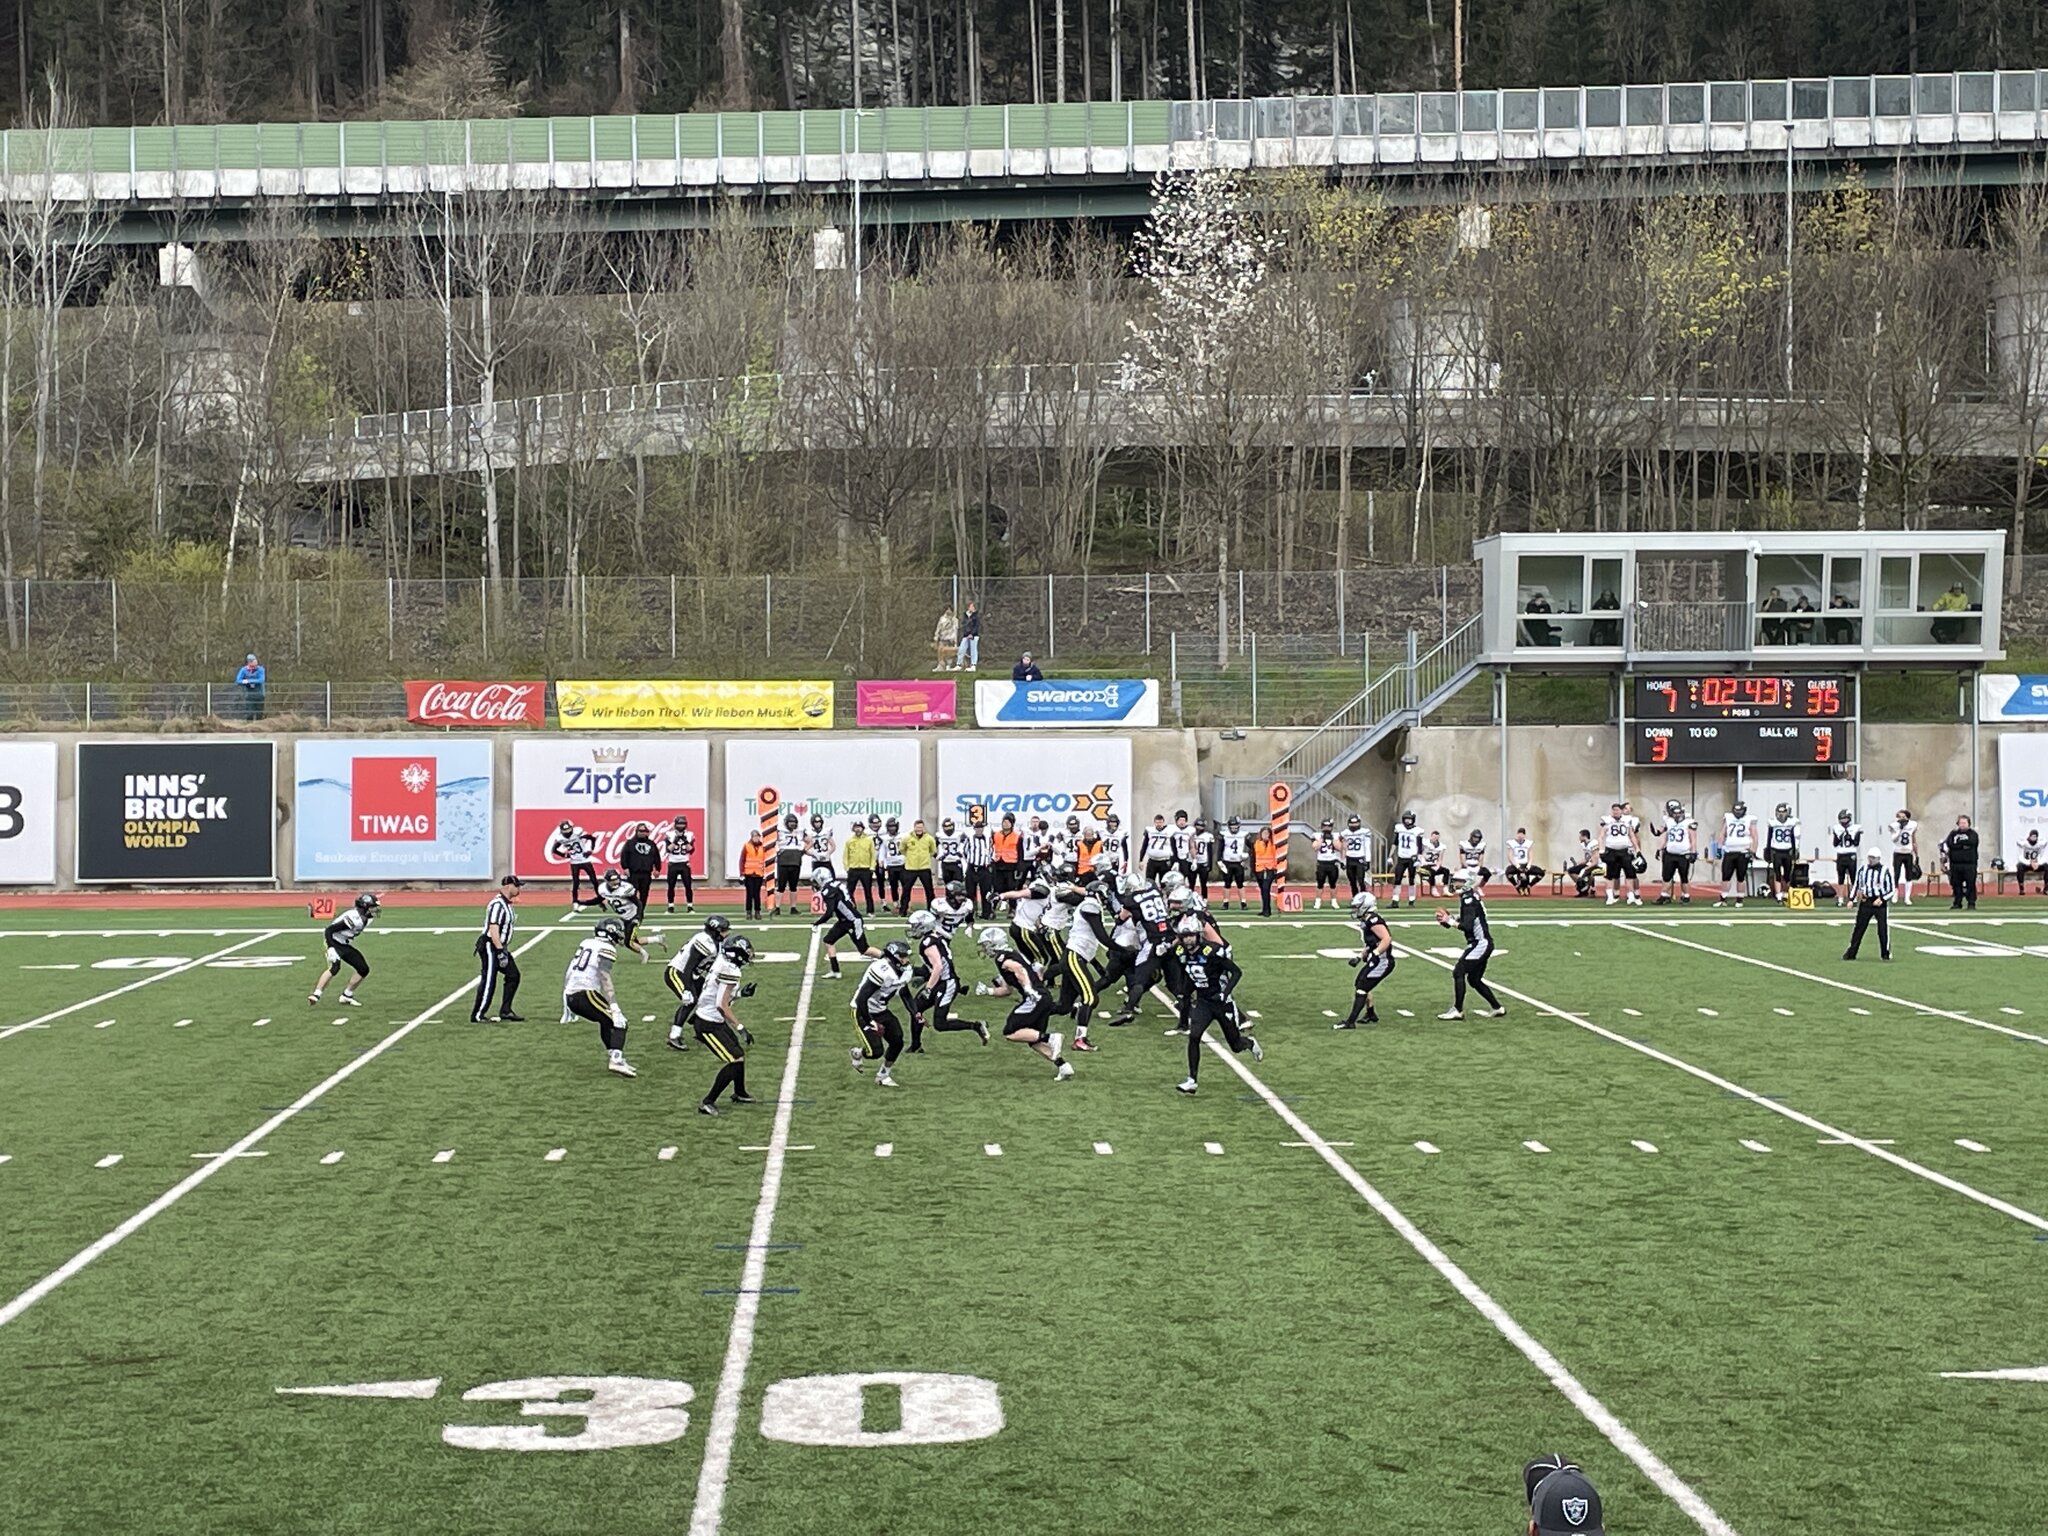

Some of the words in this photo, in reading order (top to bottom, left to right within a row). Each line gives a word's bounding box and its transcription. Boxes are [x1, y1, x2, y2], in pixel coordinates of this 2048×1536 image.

[1646, 681, 1672, 690] HOME
[1807, 680, 1837, 689] GUEST
[419, 683, 535, 721] Coca-Cola
[1027, 690, 1095, 703] swarco
[1662, 688, 1677, 713] 7
[1807, 688, 1839, 714] 35
[592, 707, 614, 718] Wir
[691, 707, 713, 718] Wir
[1645, 728, 1673, 738] DOWN
[1689, 728, 1701, 738] TO
[1703, 728, 1718, 738] GO
[1759, 728, 1783, 738] BALL
[1784, 728, 1799, 738] ON
[1812, 728, 1832, 737] QTR
[1652, 737, 1669, 762] 3
[1815, 735, 1832, 762] 3
[563, 766, 657, 803] Zipfer
[124, 797, 228, 820] BRUCK
[807, 798, 903, 819] Tageszeitung
[970, 805, 984, 824] 3
[124, 820, 201, 834] OLYMPIA
[358, 814, 430, 834] TIWAG
[1729, 823, 1746, 838] 72
[124, 835, 188, 849] WORLD
[785, 835, 799, 846] 71
[813, 838, 829, 853] 43
[1151, 836, 1167, 850] 77
[1401, 835, 1411, 849] 11
[1900, 831, 1910, 846] 8
[1230, 839, 1238, 854] 4
[443, 851, 472, 863] Tirol
[315, 899, 334, 913] 20
[1284, 894, 1301, 911] 40
[1791, 893, 1814, 908] 50
[441, 1371, 1006, 1452] 30
